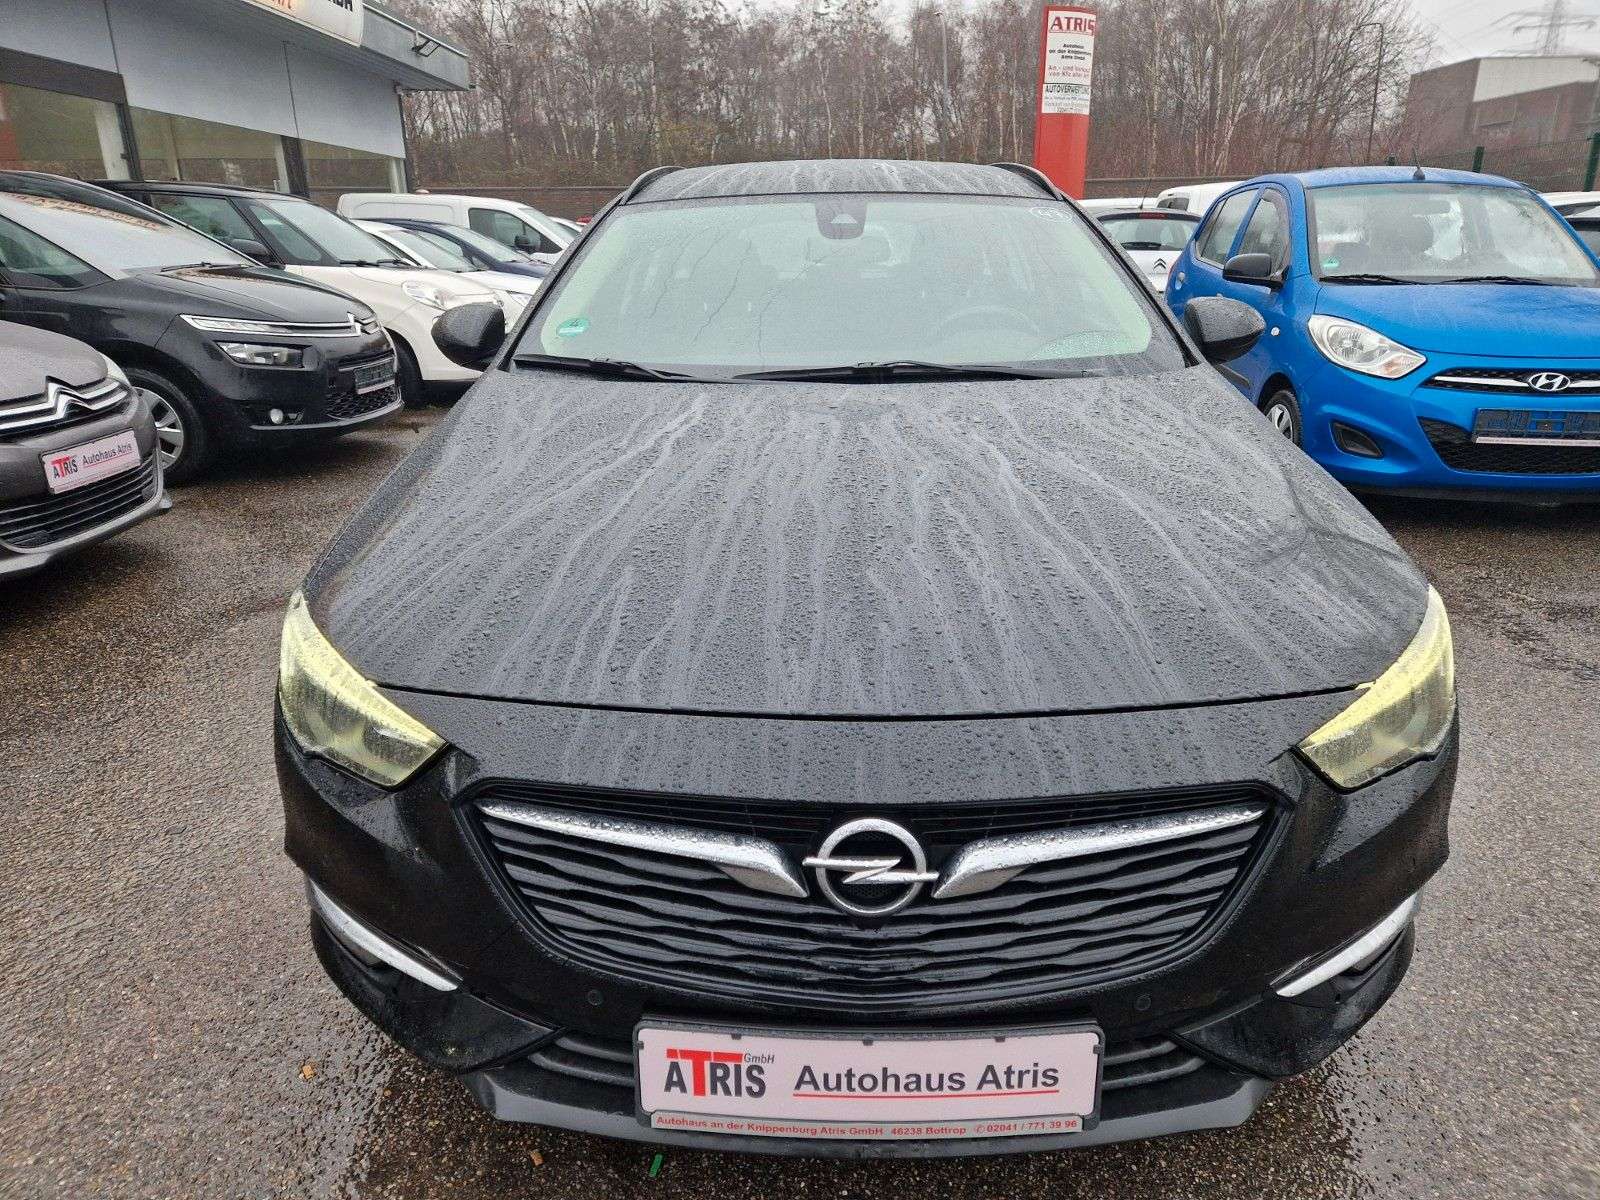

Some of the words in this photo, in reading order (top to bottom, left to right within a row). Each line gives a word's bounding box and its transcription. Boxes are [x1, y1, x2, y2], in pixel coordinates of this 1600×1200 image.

[1050, 16, 1096, 35] ATRIS
[51, 456, 78, 478] ATRIS
[82, 448, 117, 465] Autohaus
[664, 1048, 767, 1098] ATRIS
[744, 1053, 775, 1064] GmbH
[794, 1066, 966, 1092] Autohaus
[976, 1062, 1059, 1090] Atris
[656, 1116, 708, 1128] Autohaus
[727, 1122, 743, 1131] der
[747, 1123, 817, 1136] Knippenburg
[821, 1126, 847, 1136] Atris
[850, 1127, 884, 1136] GmbH
[891, 1128, 923, 1136] 46238
[926, 1125, 967, 1137] Bottrop
[1028, 1121, 1045, 1131] 771
[1049, 1121, 1062, 1129] 39
[1064, 1120, 1077, 1128] 96
